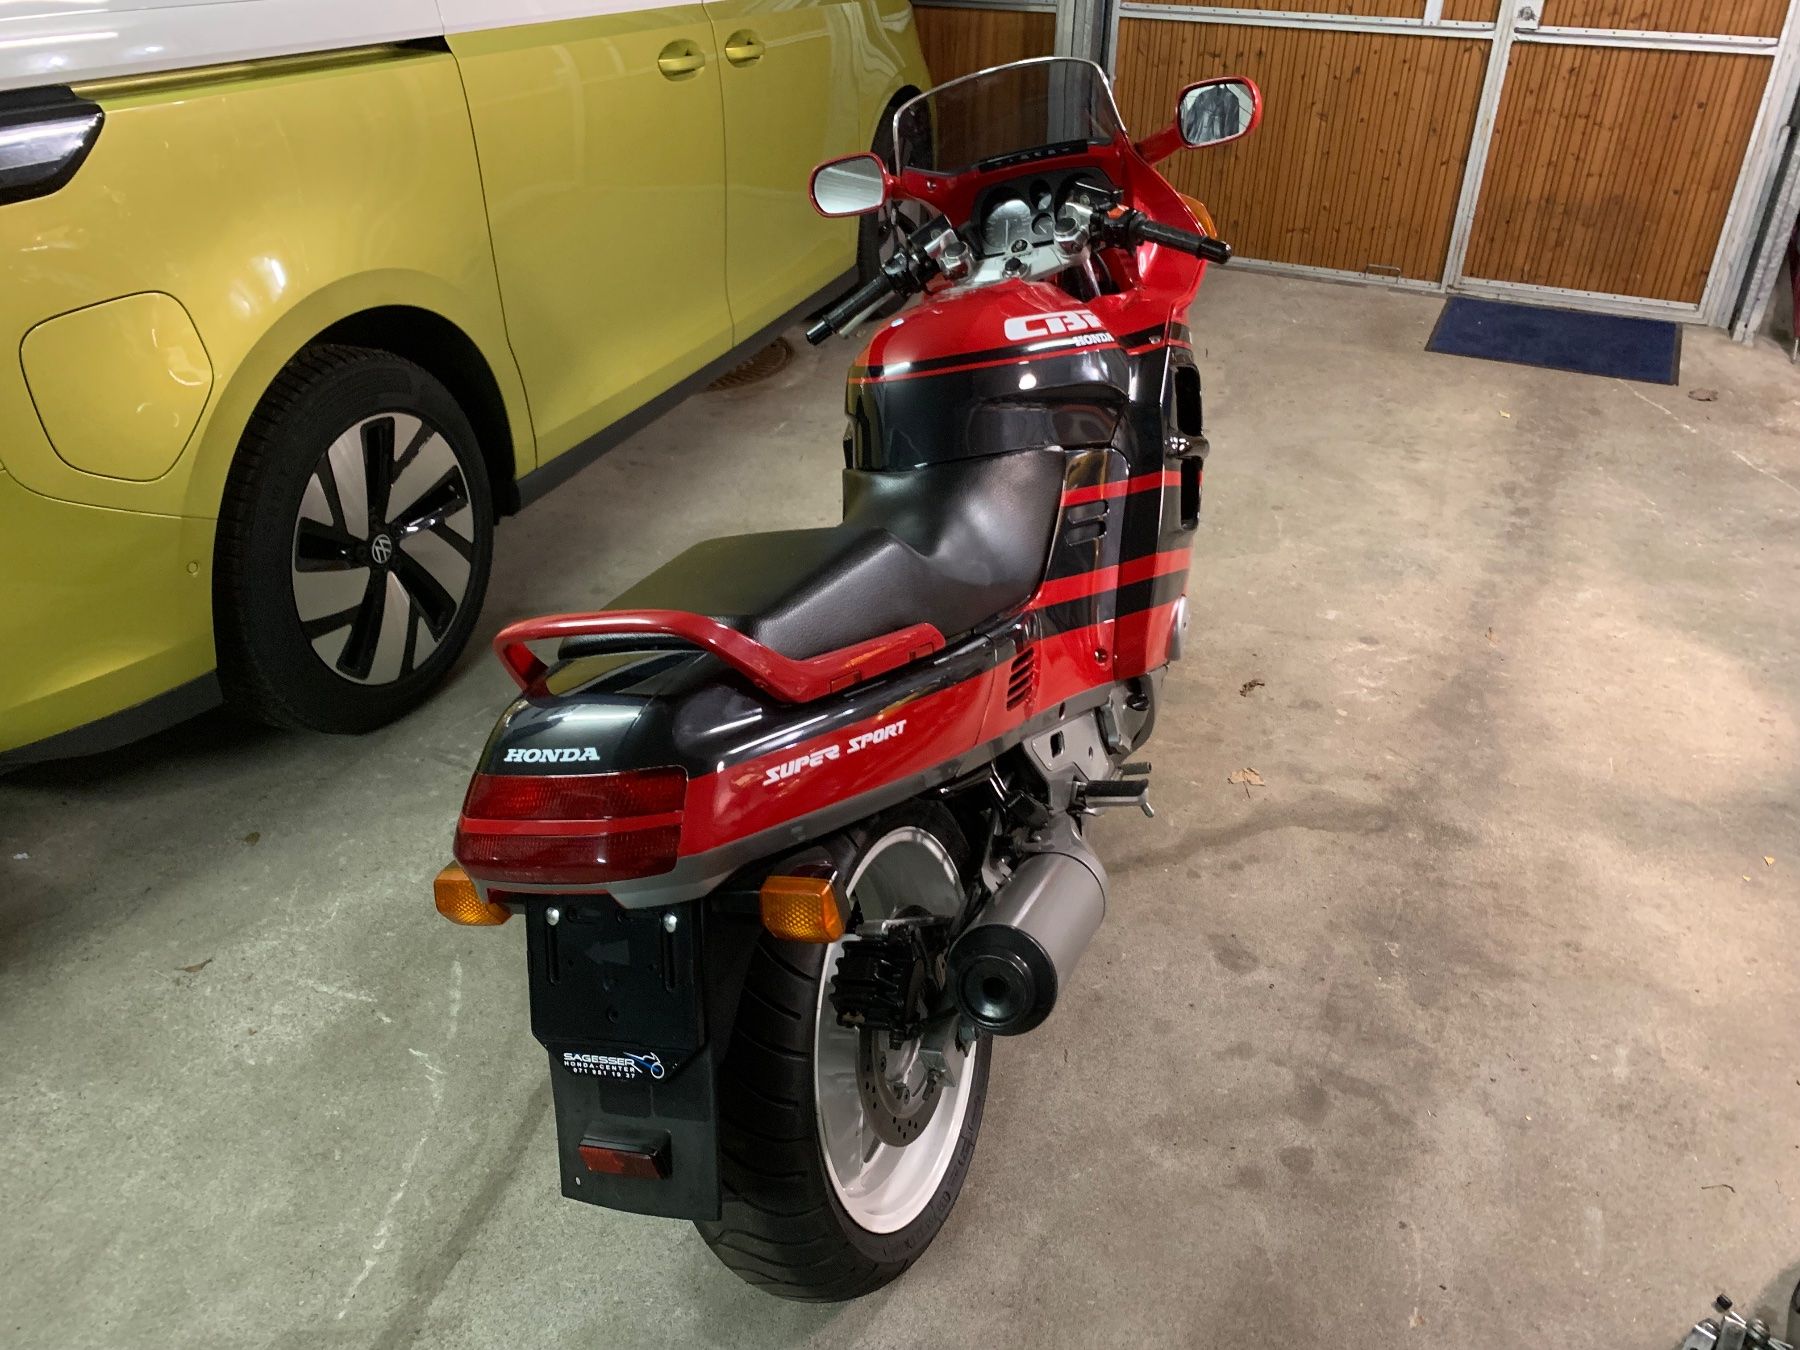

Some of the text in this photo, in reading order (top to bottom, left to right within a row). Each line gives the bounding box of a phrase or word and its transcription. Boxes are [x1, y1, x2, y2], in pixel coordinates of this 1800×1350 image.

[1072, 332, 1115, 347] HONDA
[503, 747, 600, 763] HONDA
[762, 719, 907, 786] SUPER SPORT
[563, 1052, 641, 1071] SAGESSER
[563, 1060, 635, 1073] HONDA-CENTER
